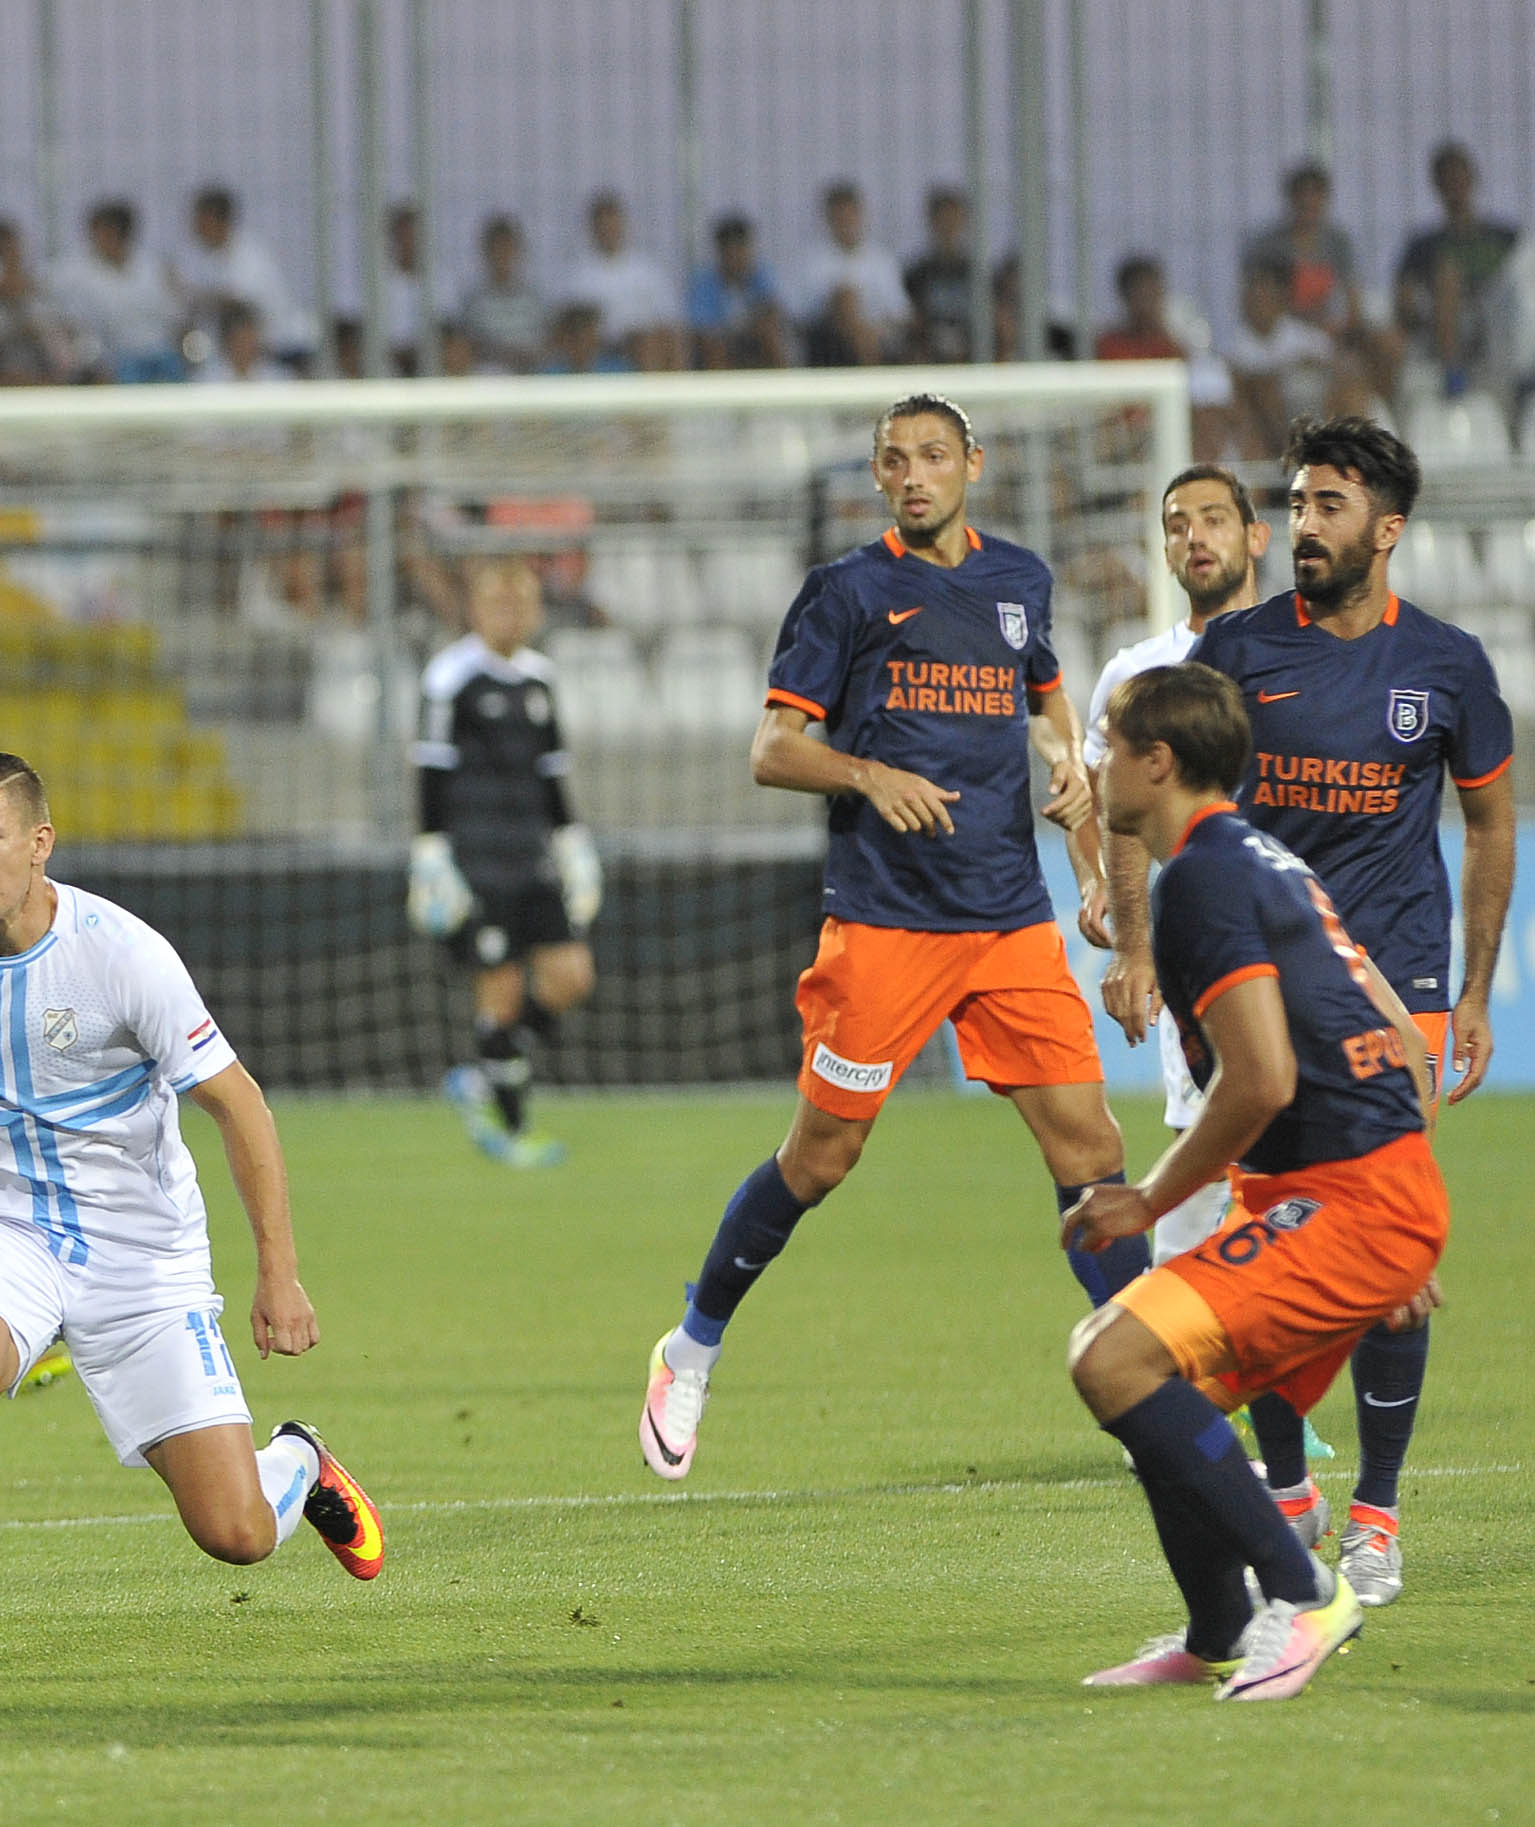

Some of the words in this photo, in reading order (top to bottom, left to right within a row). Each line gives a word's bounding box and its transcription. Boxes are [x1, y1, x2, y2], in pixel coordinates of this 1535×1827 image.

[887, 660, 1016, 691] TURKISH
[885, 686, 1017, 717] AIRLINES
[1256, 752, 1407, 788] TURKISH
[1252, 781, 1401, 815] AIRLINES
[1219, 1222, 1278, 1266] 6
